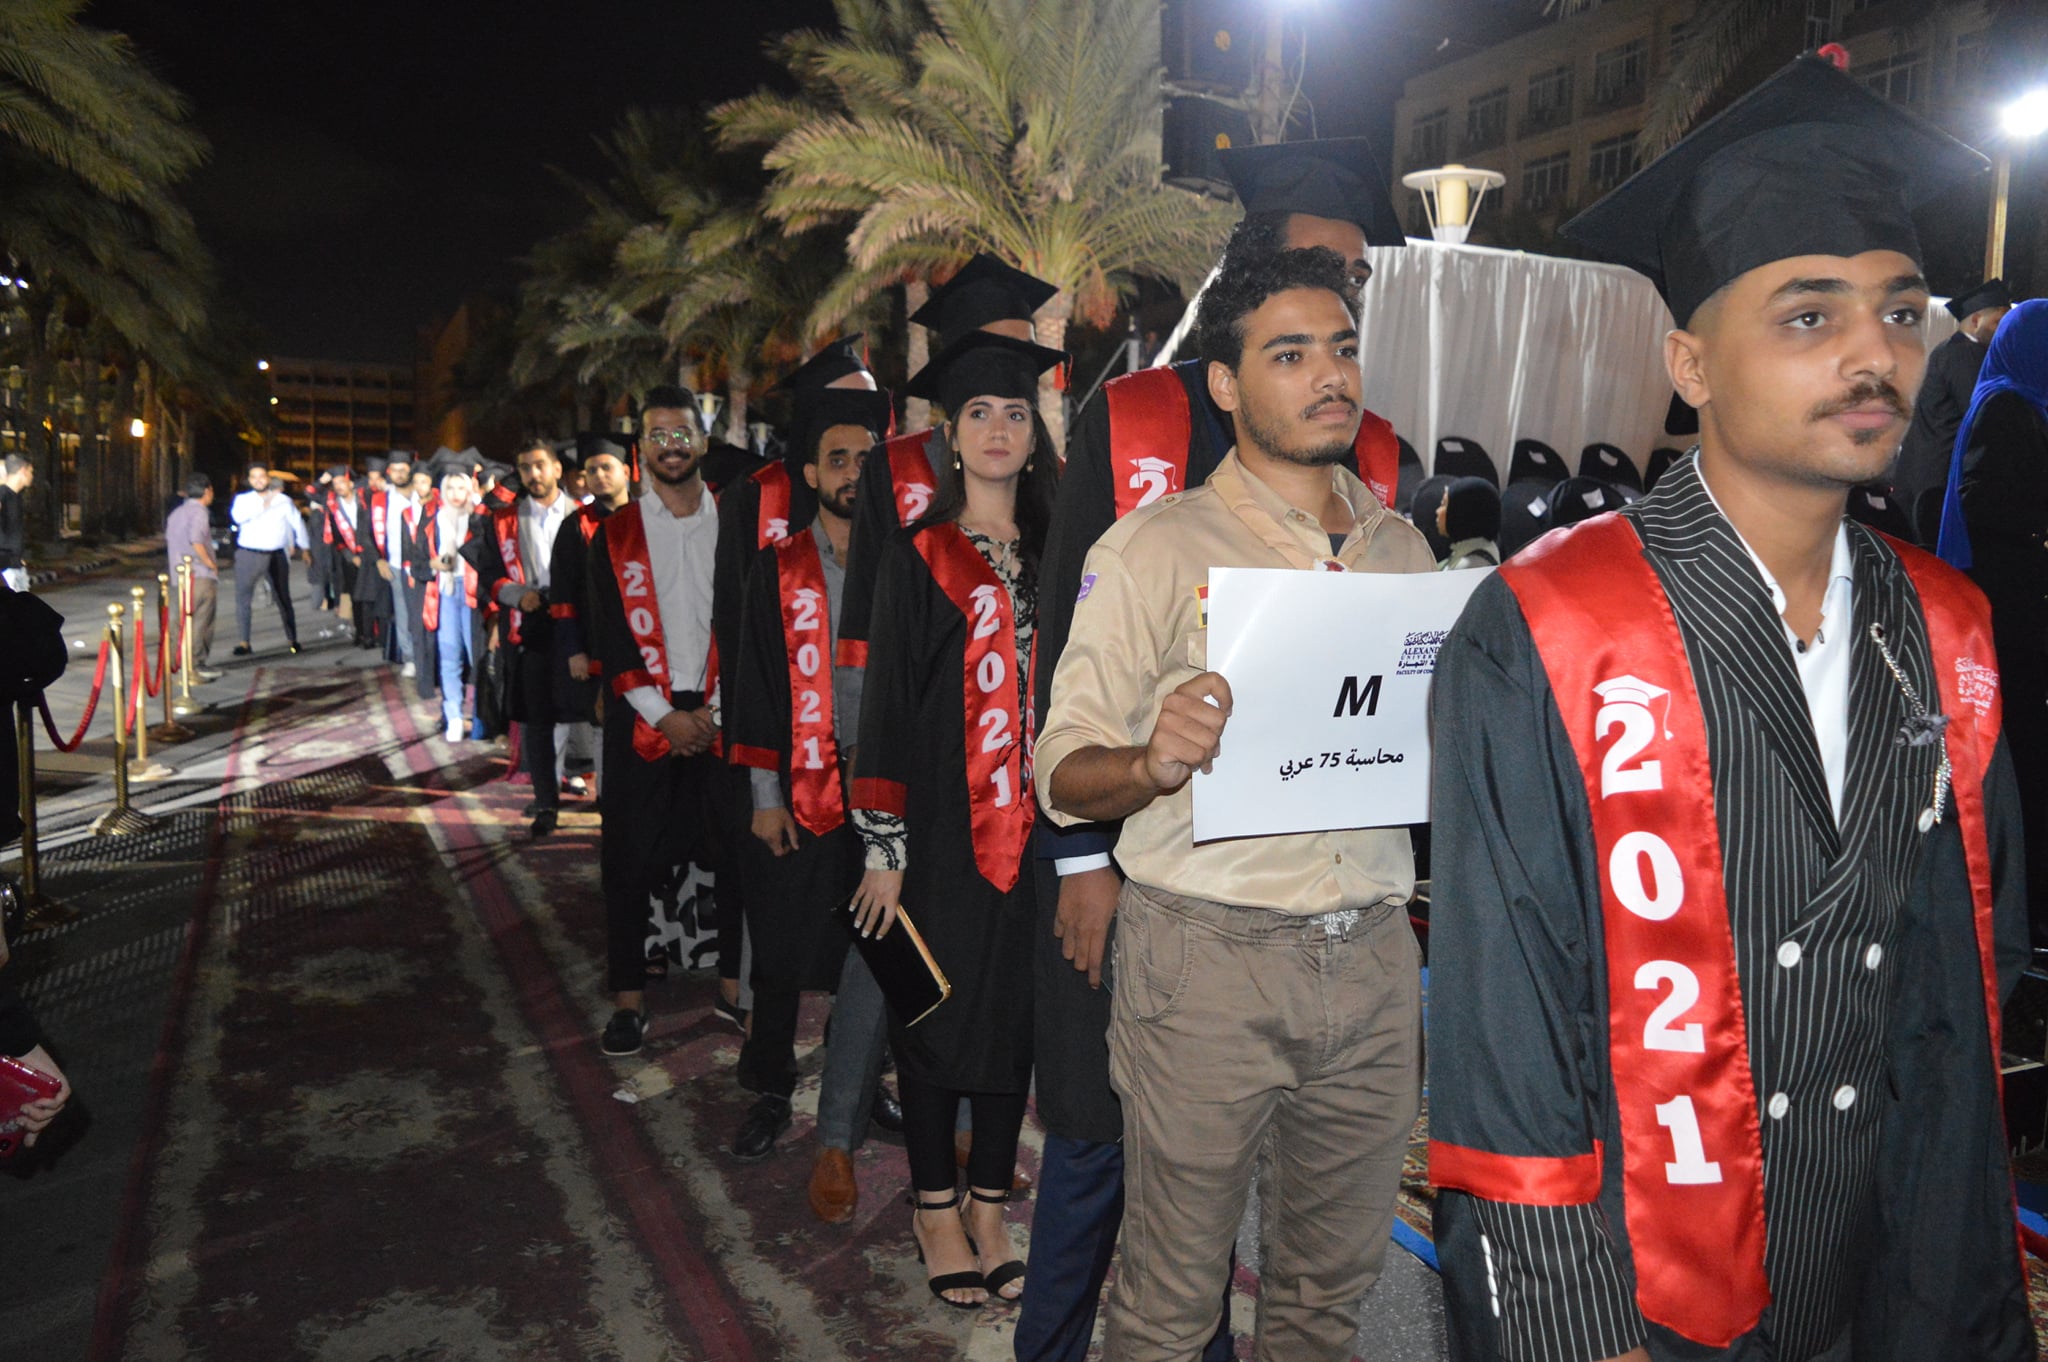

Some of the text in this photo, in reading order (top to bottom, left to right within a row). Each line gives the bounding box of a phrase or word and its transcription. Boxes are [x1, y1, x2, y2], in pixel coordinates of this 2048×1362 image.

[622, 568, 664, 698] 202
[793, 598, 825, 769] 2021
[1333, 675, 1382, 717] M
[1402, 647, 1440, 655] ALEXAND
[973, 595, 1013, 807] 2021
[1279, 748, 1404, 781] محاسبة 75 عربي
[1595, 700, 1722, 1185] 2021
